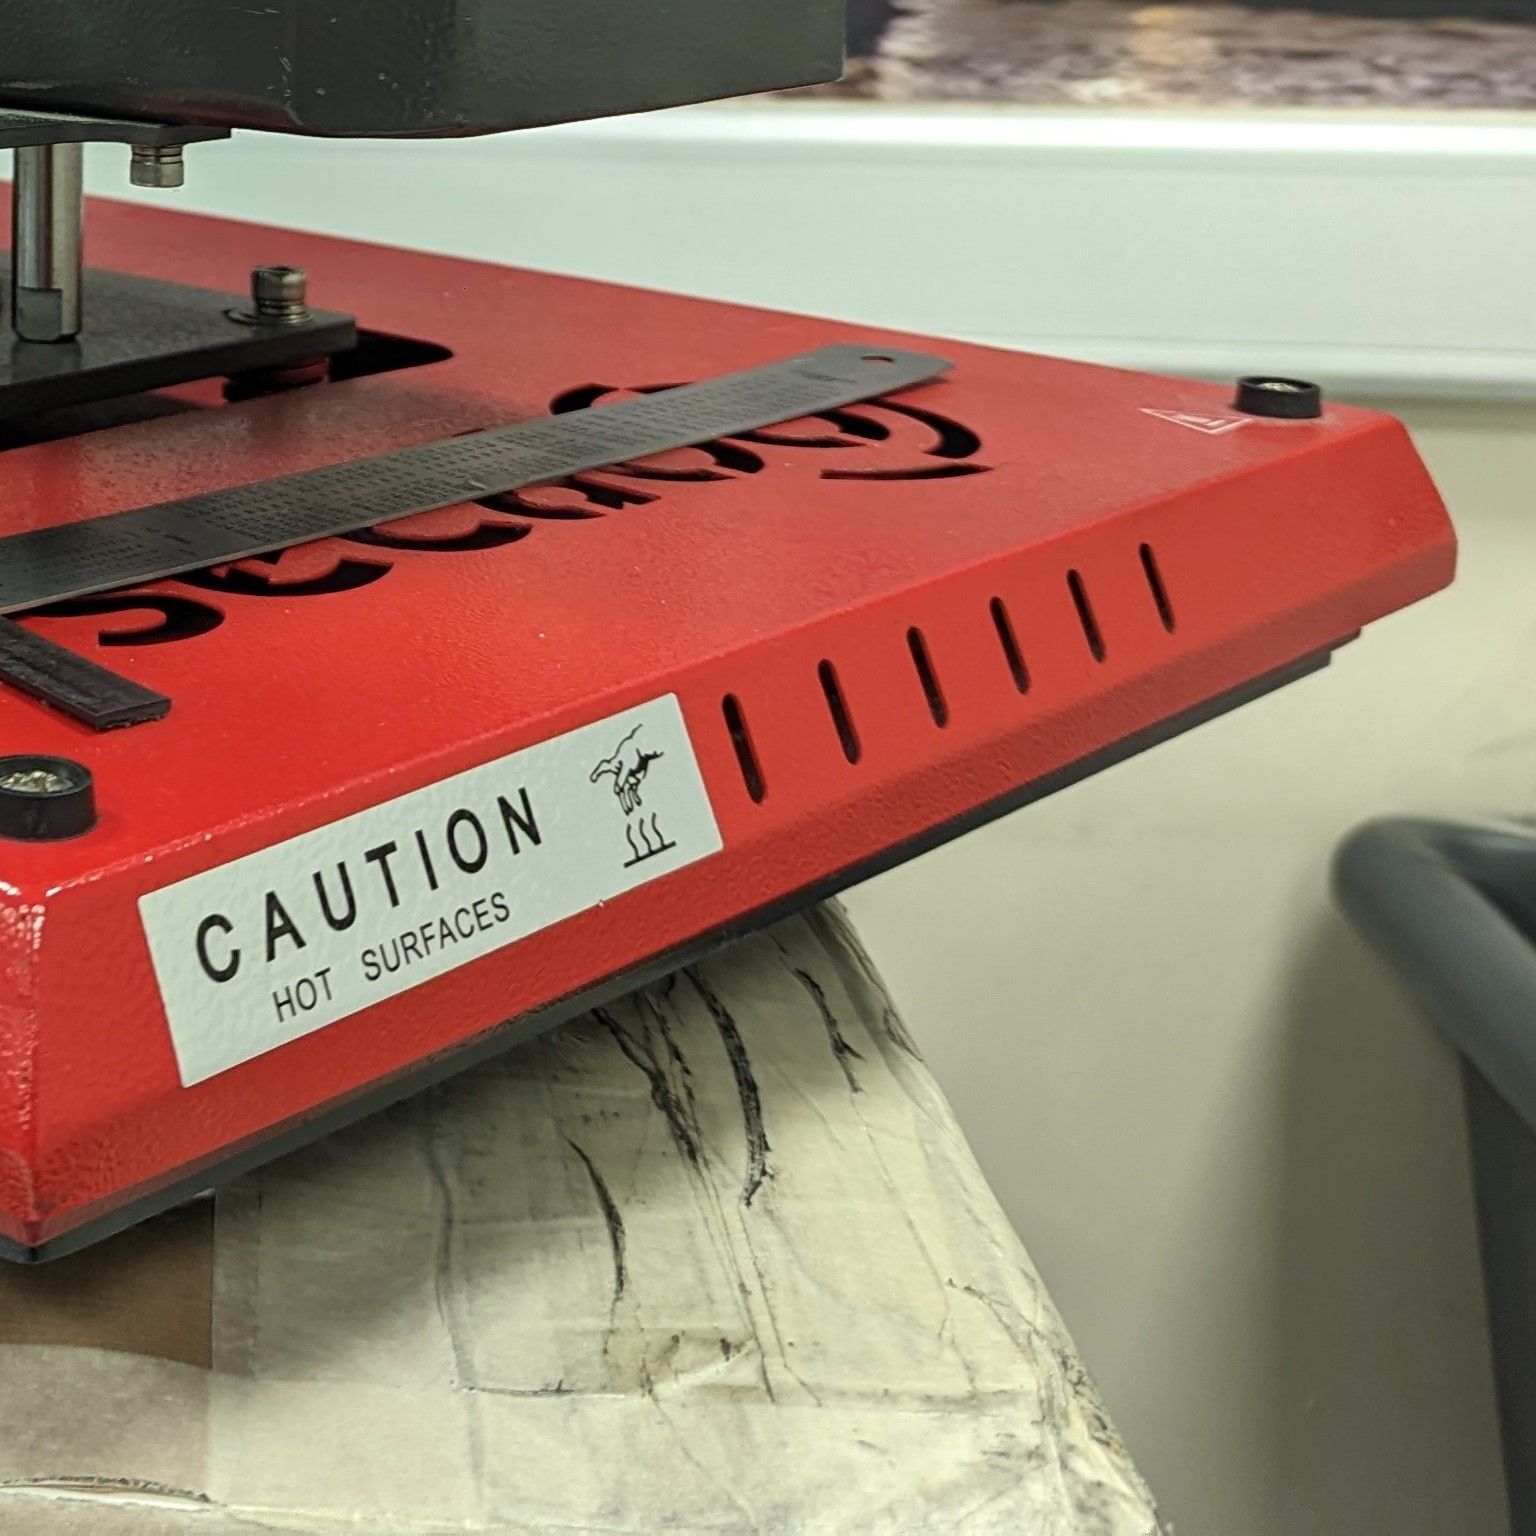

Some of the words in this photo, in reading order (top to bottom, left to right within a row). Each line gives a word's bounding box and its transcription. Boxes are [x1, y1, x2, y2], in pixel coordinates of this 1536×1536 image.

[195, 787, 542, 983] CAUTION
[272, 967, 333, 1023] HOT
[361, 892, 511, 982] SURFACES
